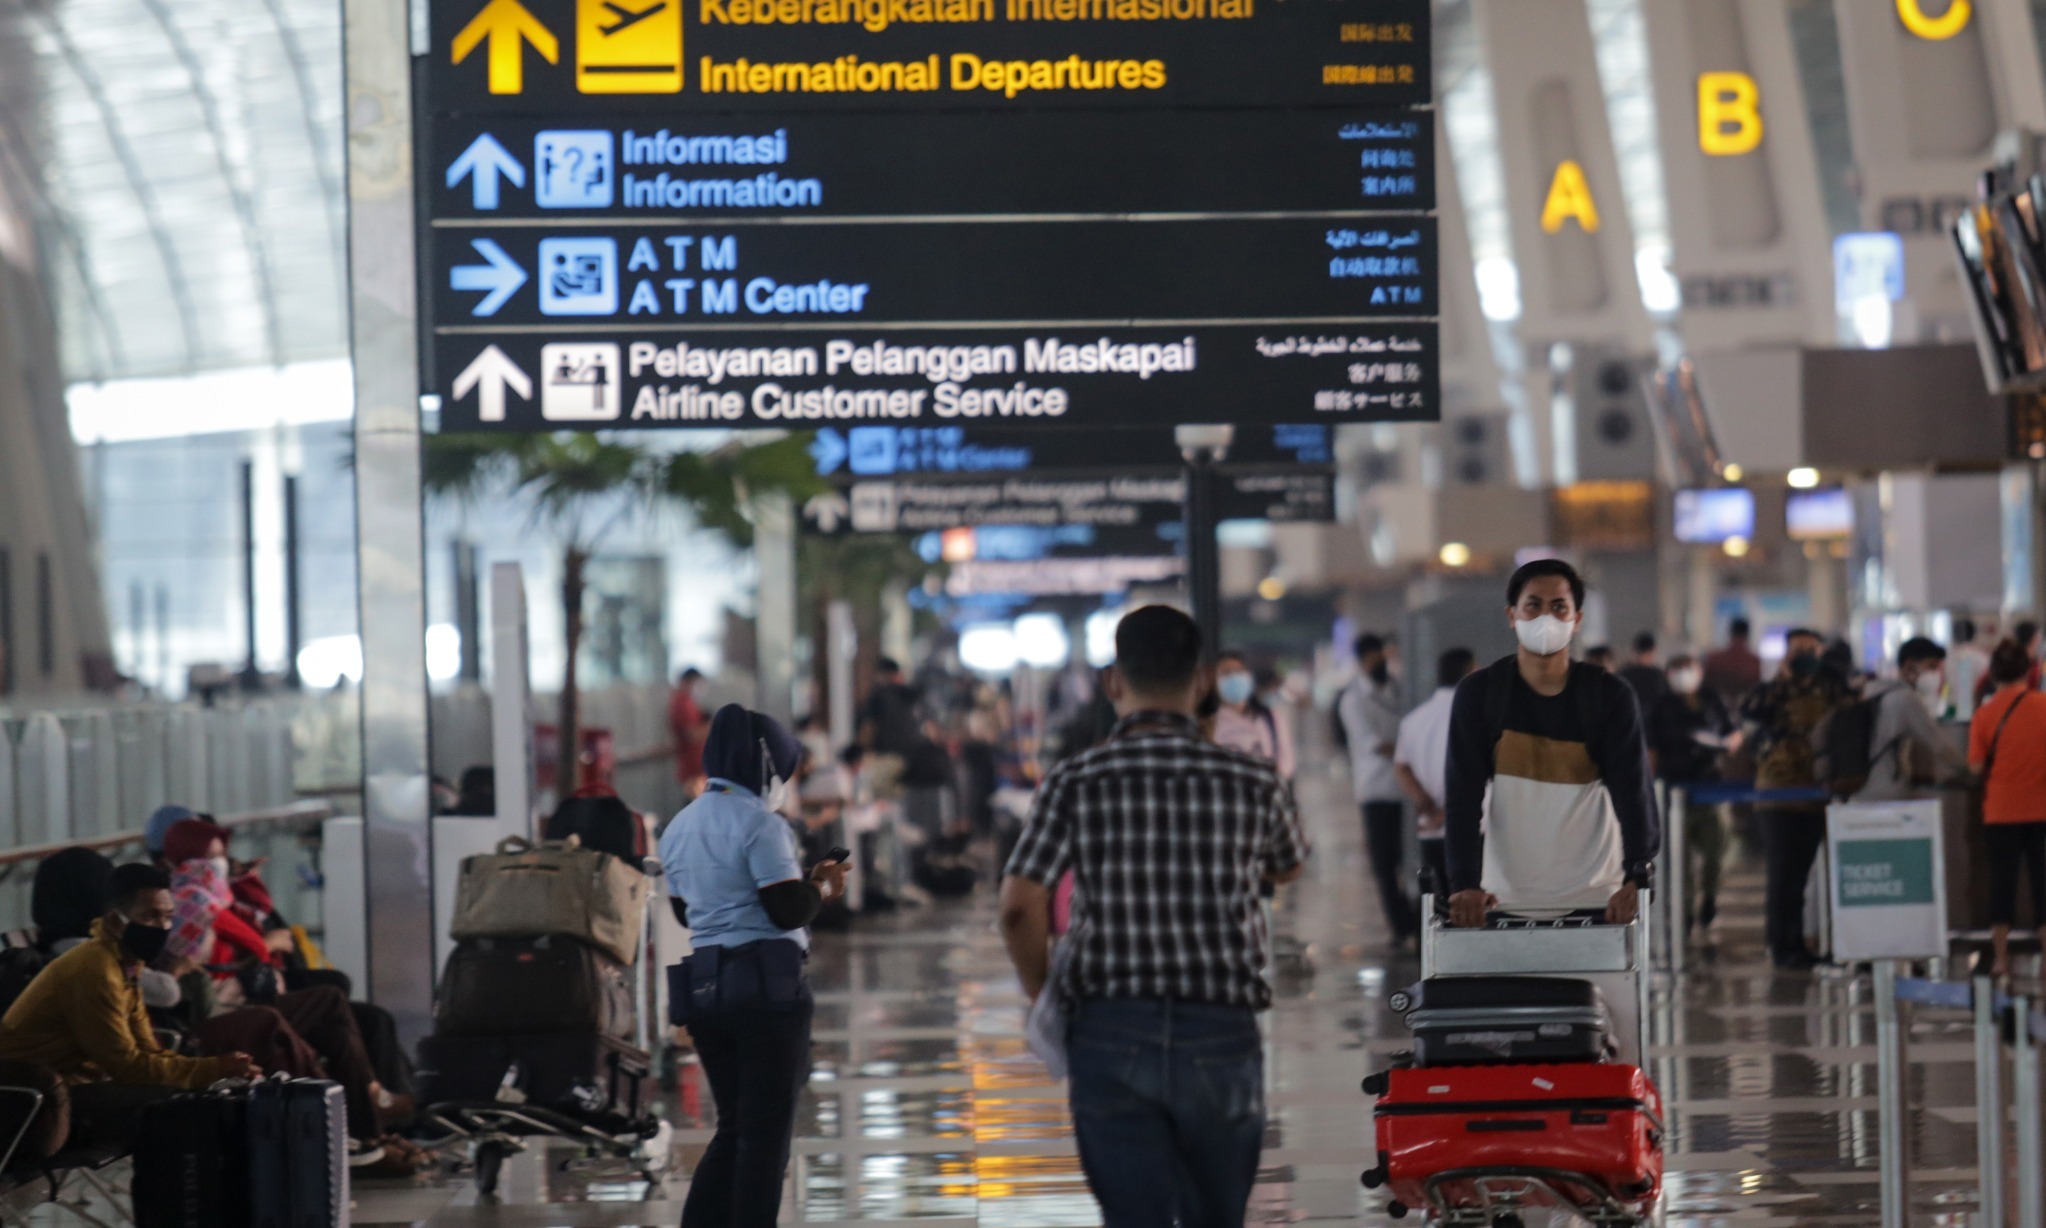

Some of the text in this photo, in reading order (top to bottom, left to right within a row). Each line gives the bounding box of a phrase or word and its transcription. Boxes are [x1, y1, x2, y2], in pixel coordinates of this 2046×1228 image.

[700, 0, 994, 32] Keberangkatan
[700, 53, 1167, 98] International Departures
[1698, 72, 1763, 155] B
[622, 128, 788, 165] Informasi
[622, 172, 823, 208] Information
[1540, 160, 1600, 233] A
[744, 276, 870, 314] Center
[629, 336, 1196, 384] Pelayanan Pelanggan Maskapai
[631, 380, 1068, 420] Airline Customer Service
